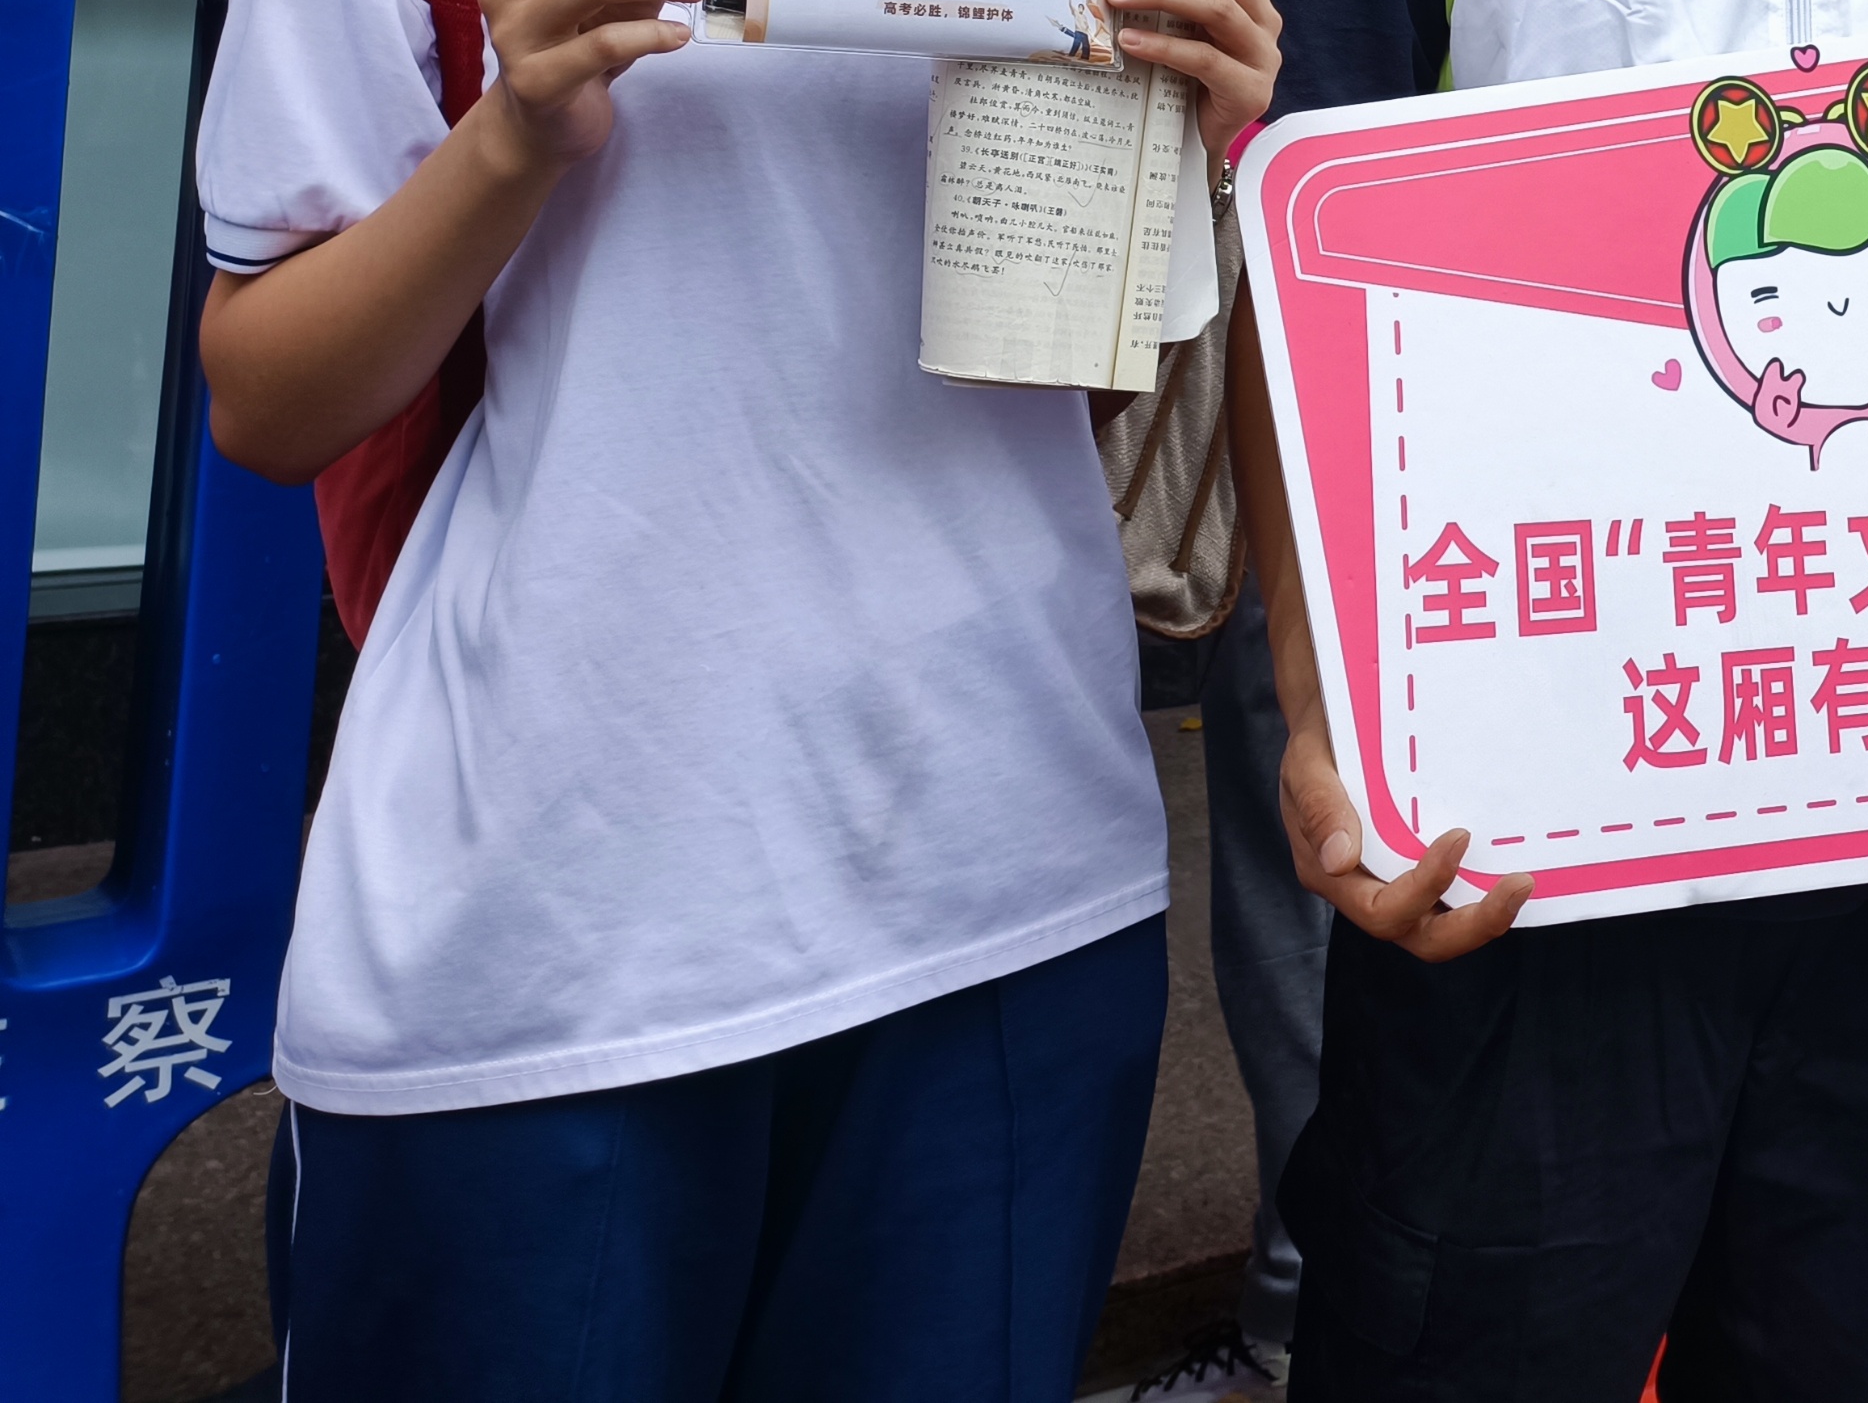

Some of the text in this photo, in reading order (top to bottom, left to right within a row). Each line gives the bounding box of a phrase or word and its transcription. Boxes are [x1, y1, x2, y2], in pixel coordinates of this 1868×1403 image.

[882, 0, 1015, 24] 高考必胜，锦鲤护体
